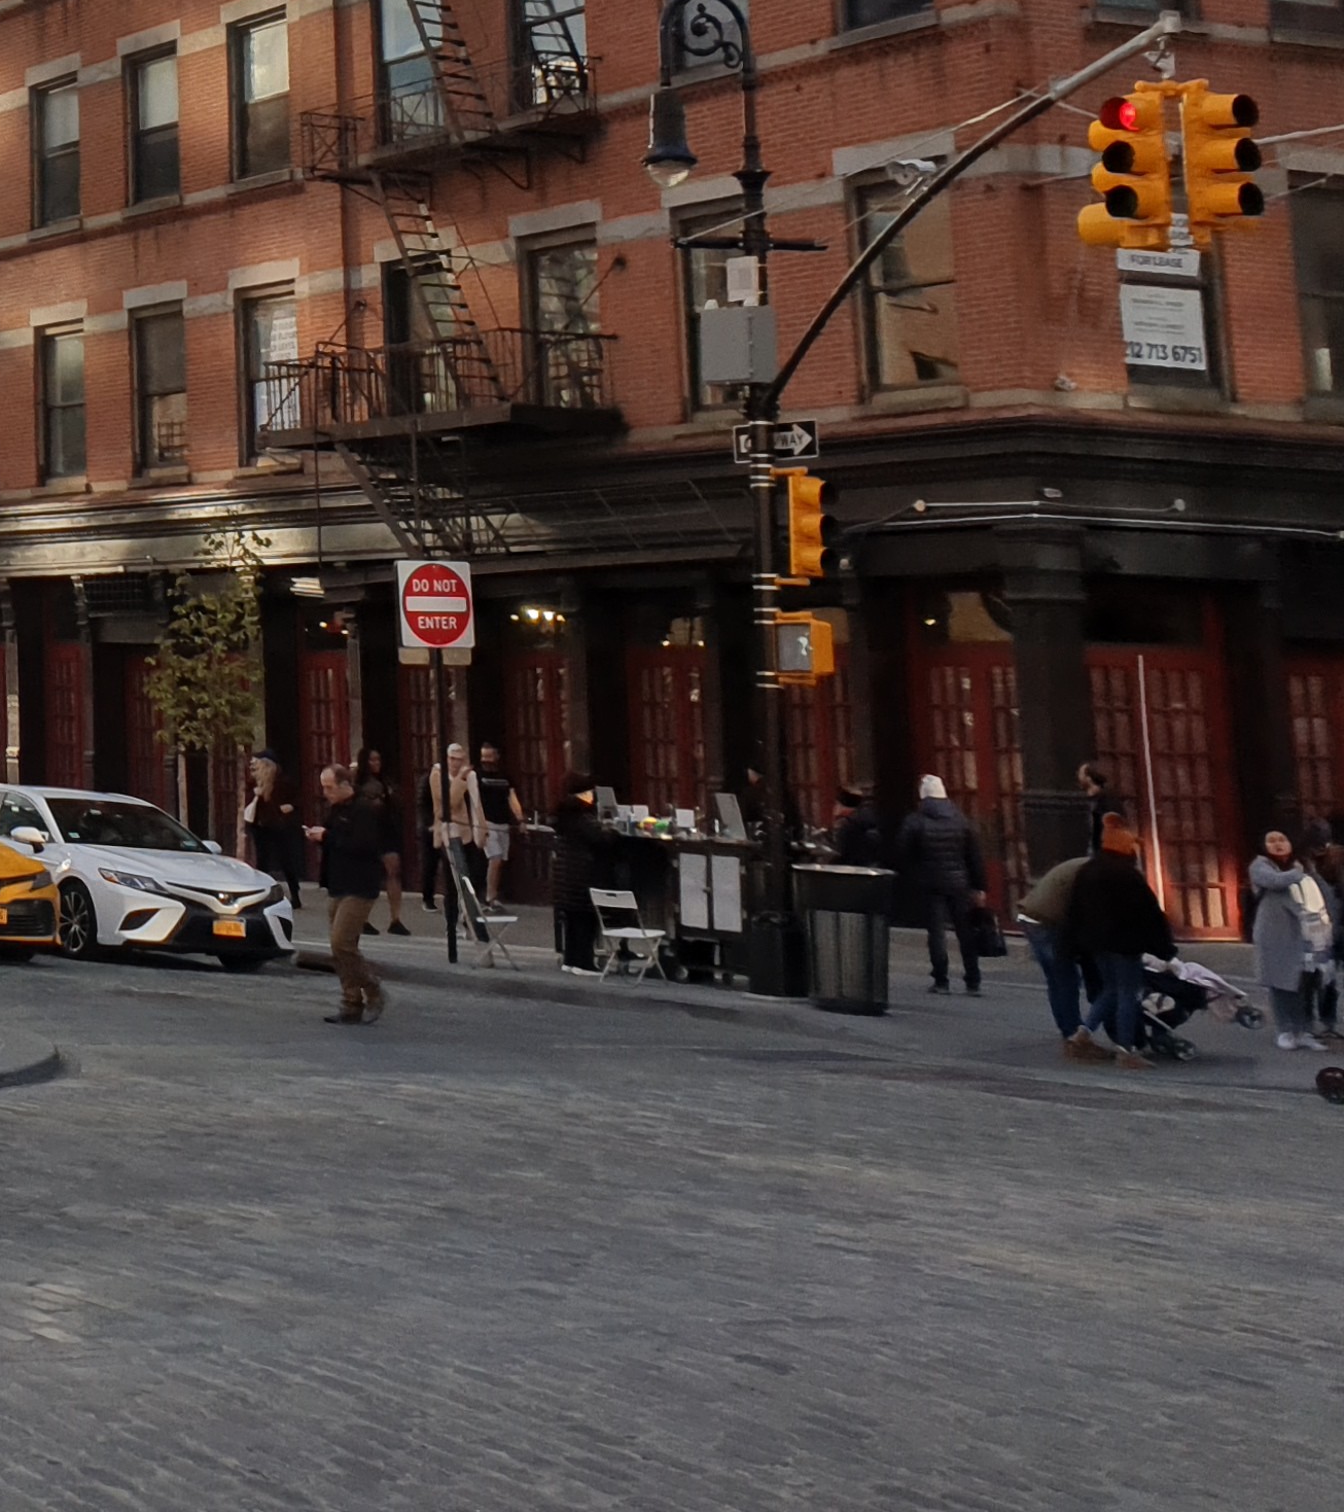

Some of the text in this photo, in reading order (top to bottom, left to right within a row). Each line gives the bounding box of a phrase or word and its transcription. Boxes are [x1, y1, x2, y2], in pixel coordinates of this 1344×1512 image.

[1125, 340, 1203, 364] 12 713 6751
[412, 579, 457, 593] DO NOT
[417, 616, 458, 630] ENTER
